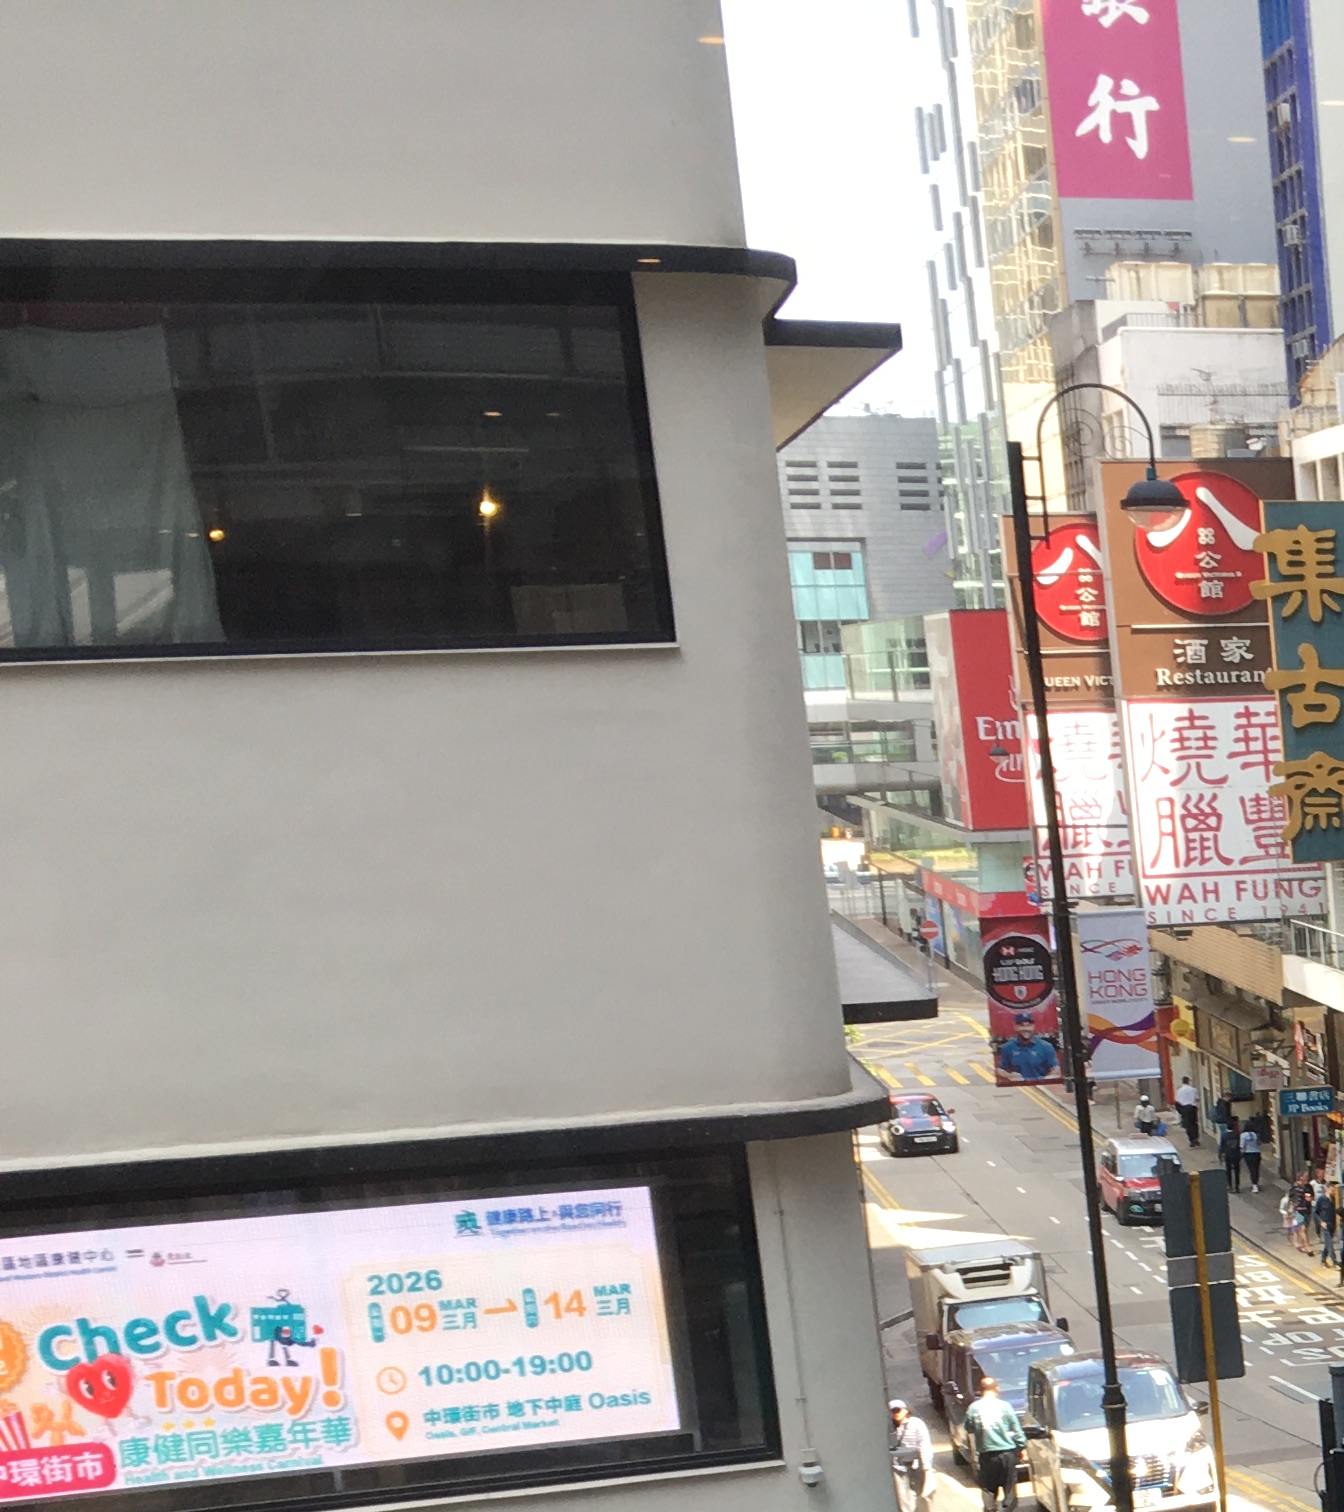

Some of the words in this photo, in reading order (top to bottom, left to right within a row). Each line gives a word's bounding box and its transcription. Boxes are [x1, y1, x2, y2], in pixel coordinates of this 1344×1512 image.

[1173, 636, 1255, 664] 酒家
[1043, 676, 1082, 687] UEEN
[1141, 707, 1235, 869] 燒臘
[1040, 882, 1117, 897] SNCE
[1145, 881, 1221, 906] WAH
[1234, 878, 1322, 903] FUNG
[1147, 906, 1237, 925] SINCE
[1261, 901, 1326, 919] 1941
[1087, 968, 1147, 985] HONG
[1089, 983, 1148, 999] KONG
[367, 1269, 444, 1296] 2026
[593, 1283, 632, 1297] MAR
[389, 1302, 438, 1335] 09
[544, 1289, 587, 1320] 14
[438, 1298, 478, 1311] MAR
[596, 1298, 631, 1317] 三月
[38, 1294, 239, 1371] Check
[442, 1312, 478, 1331] 三月
[145, 1347, 343, 1416] Today!
[418, 1350, 593, 1387] 10:00-19:00
[423, 1403, 500, 1426] 中環街市
[506, 1394, 583, 1418] 地下中庭
[588, 1389, 652, 1410] Oasis
[119, 1416, 352, 1469] 康健同樂嘉年華
